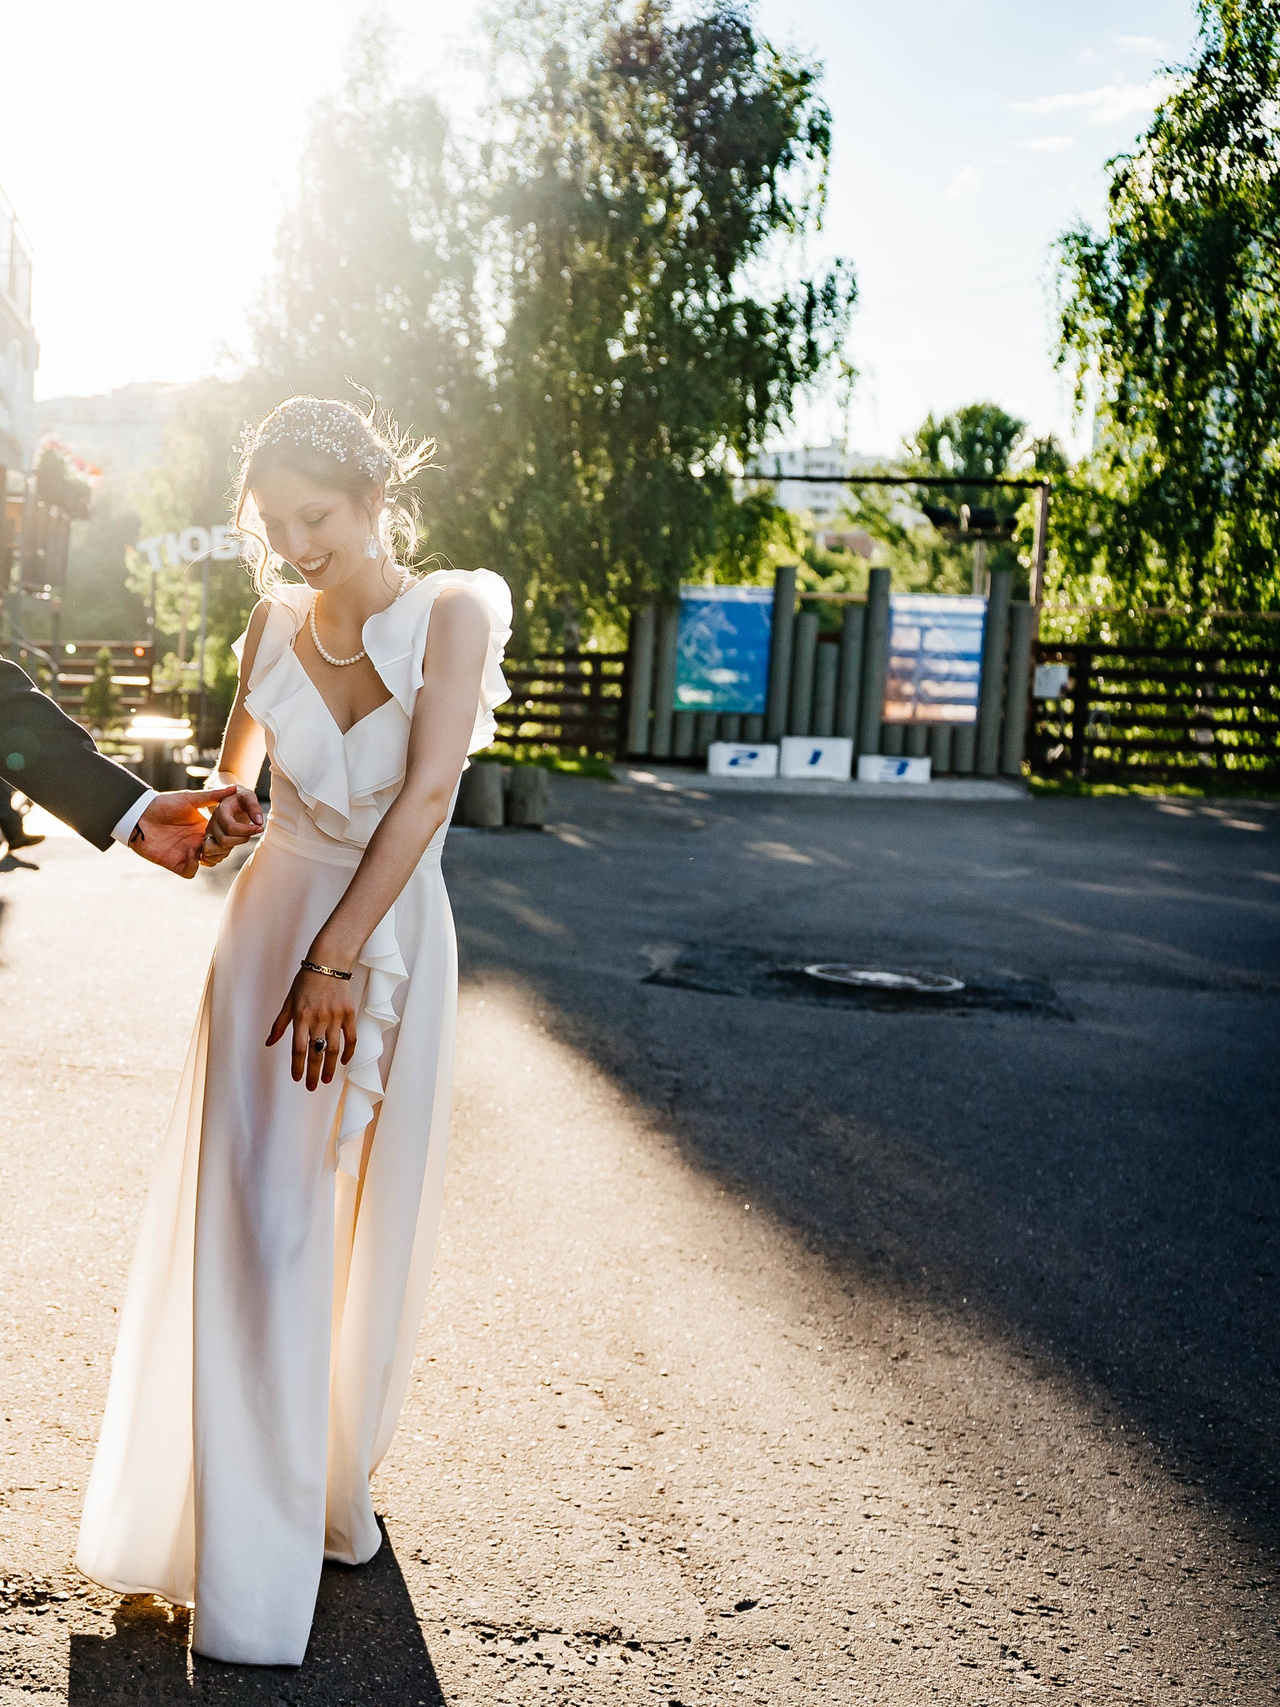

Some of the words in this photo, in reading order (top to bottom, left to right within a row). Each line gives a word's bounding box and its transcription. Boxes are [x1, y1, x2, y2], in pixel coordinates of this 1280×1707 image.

[728, 749, 759, 768] 2
[808, 749, 823, 766] 1
[880, 757, 910, 780] 3
